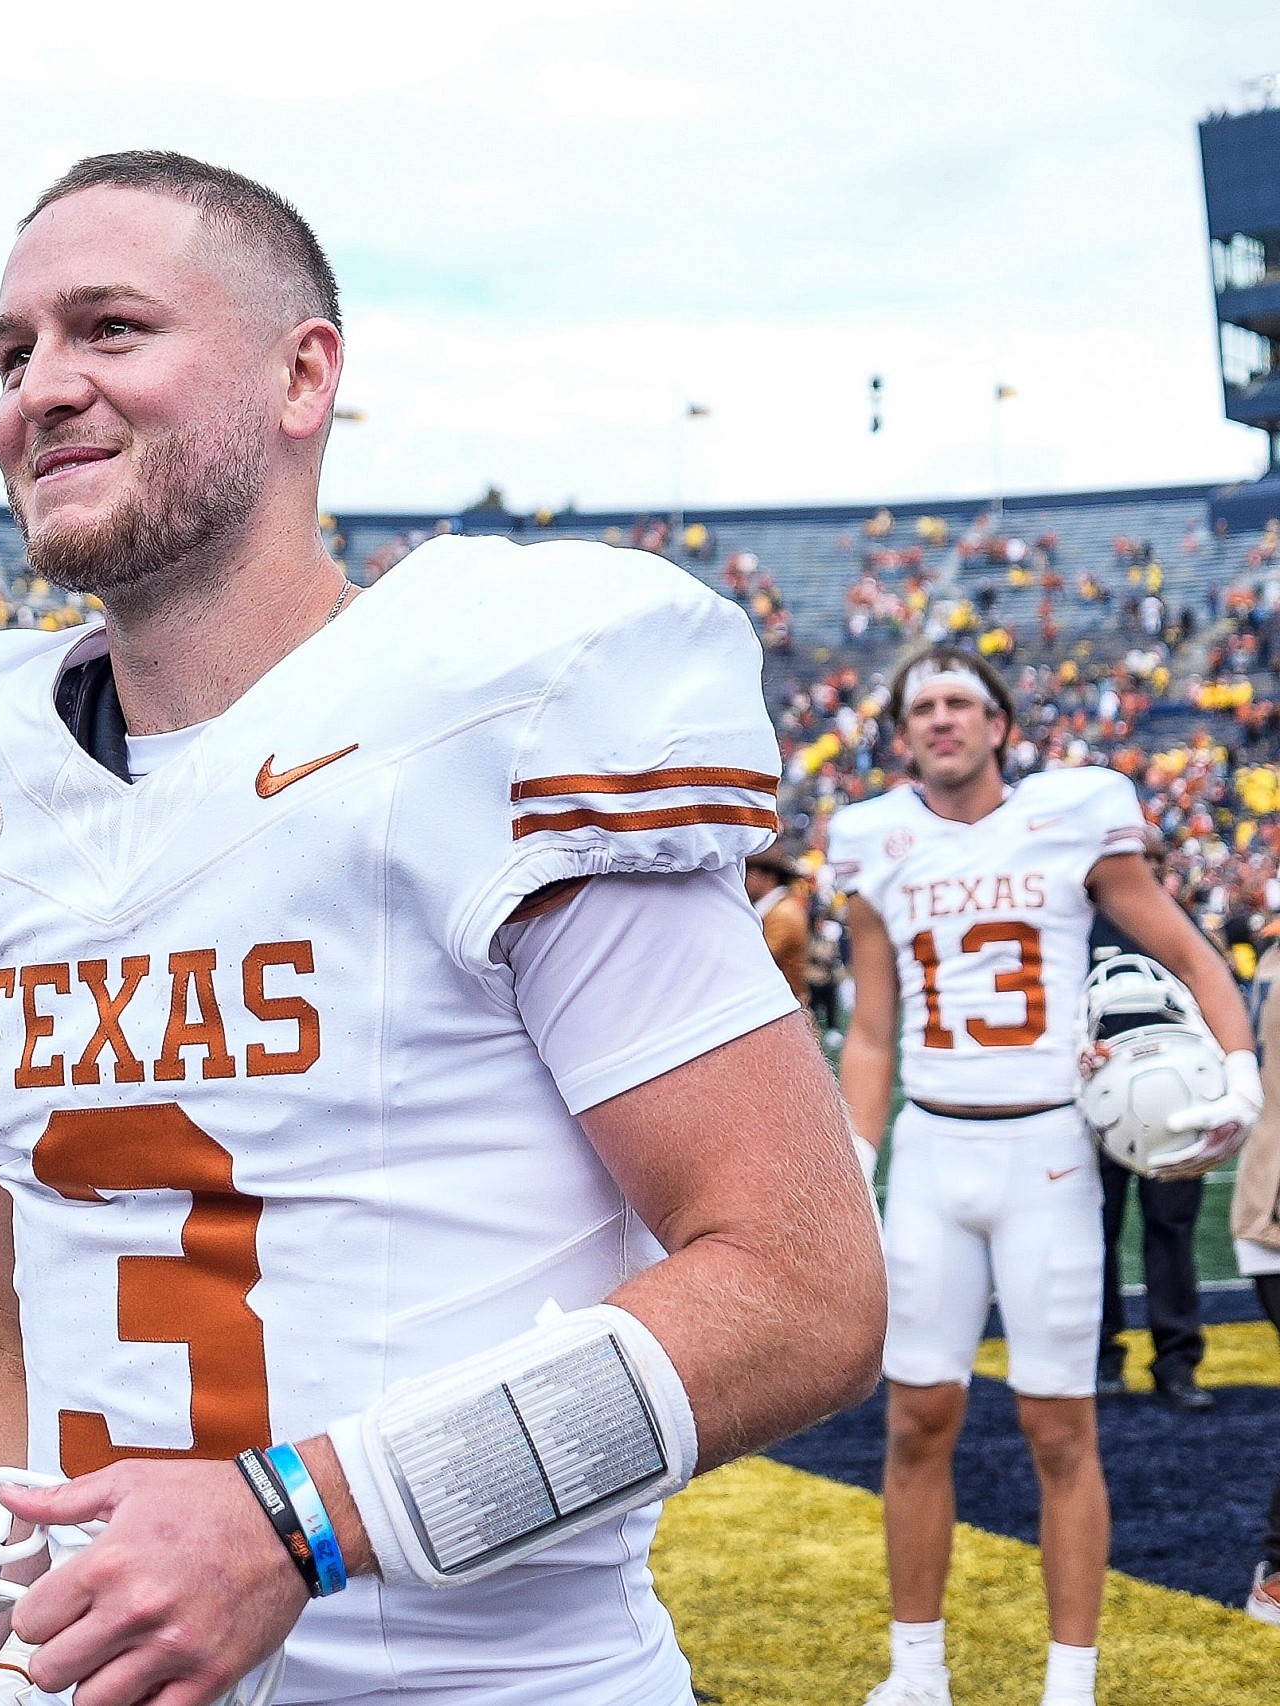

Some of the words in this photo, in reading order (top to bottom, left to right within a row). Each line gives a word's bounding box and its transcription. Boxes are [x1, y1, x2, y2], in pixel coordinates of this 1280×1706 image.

[901, 872, 1047, 921] TEXAS
[912, 922, 1047, 1050] 13
[31, 1102, 272, 1482] 3
